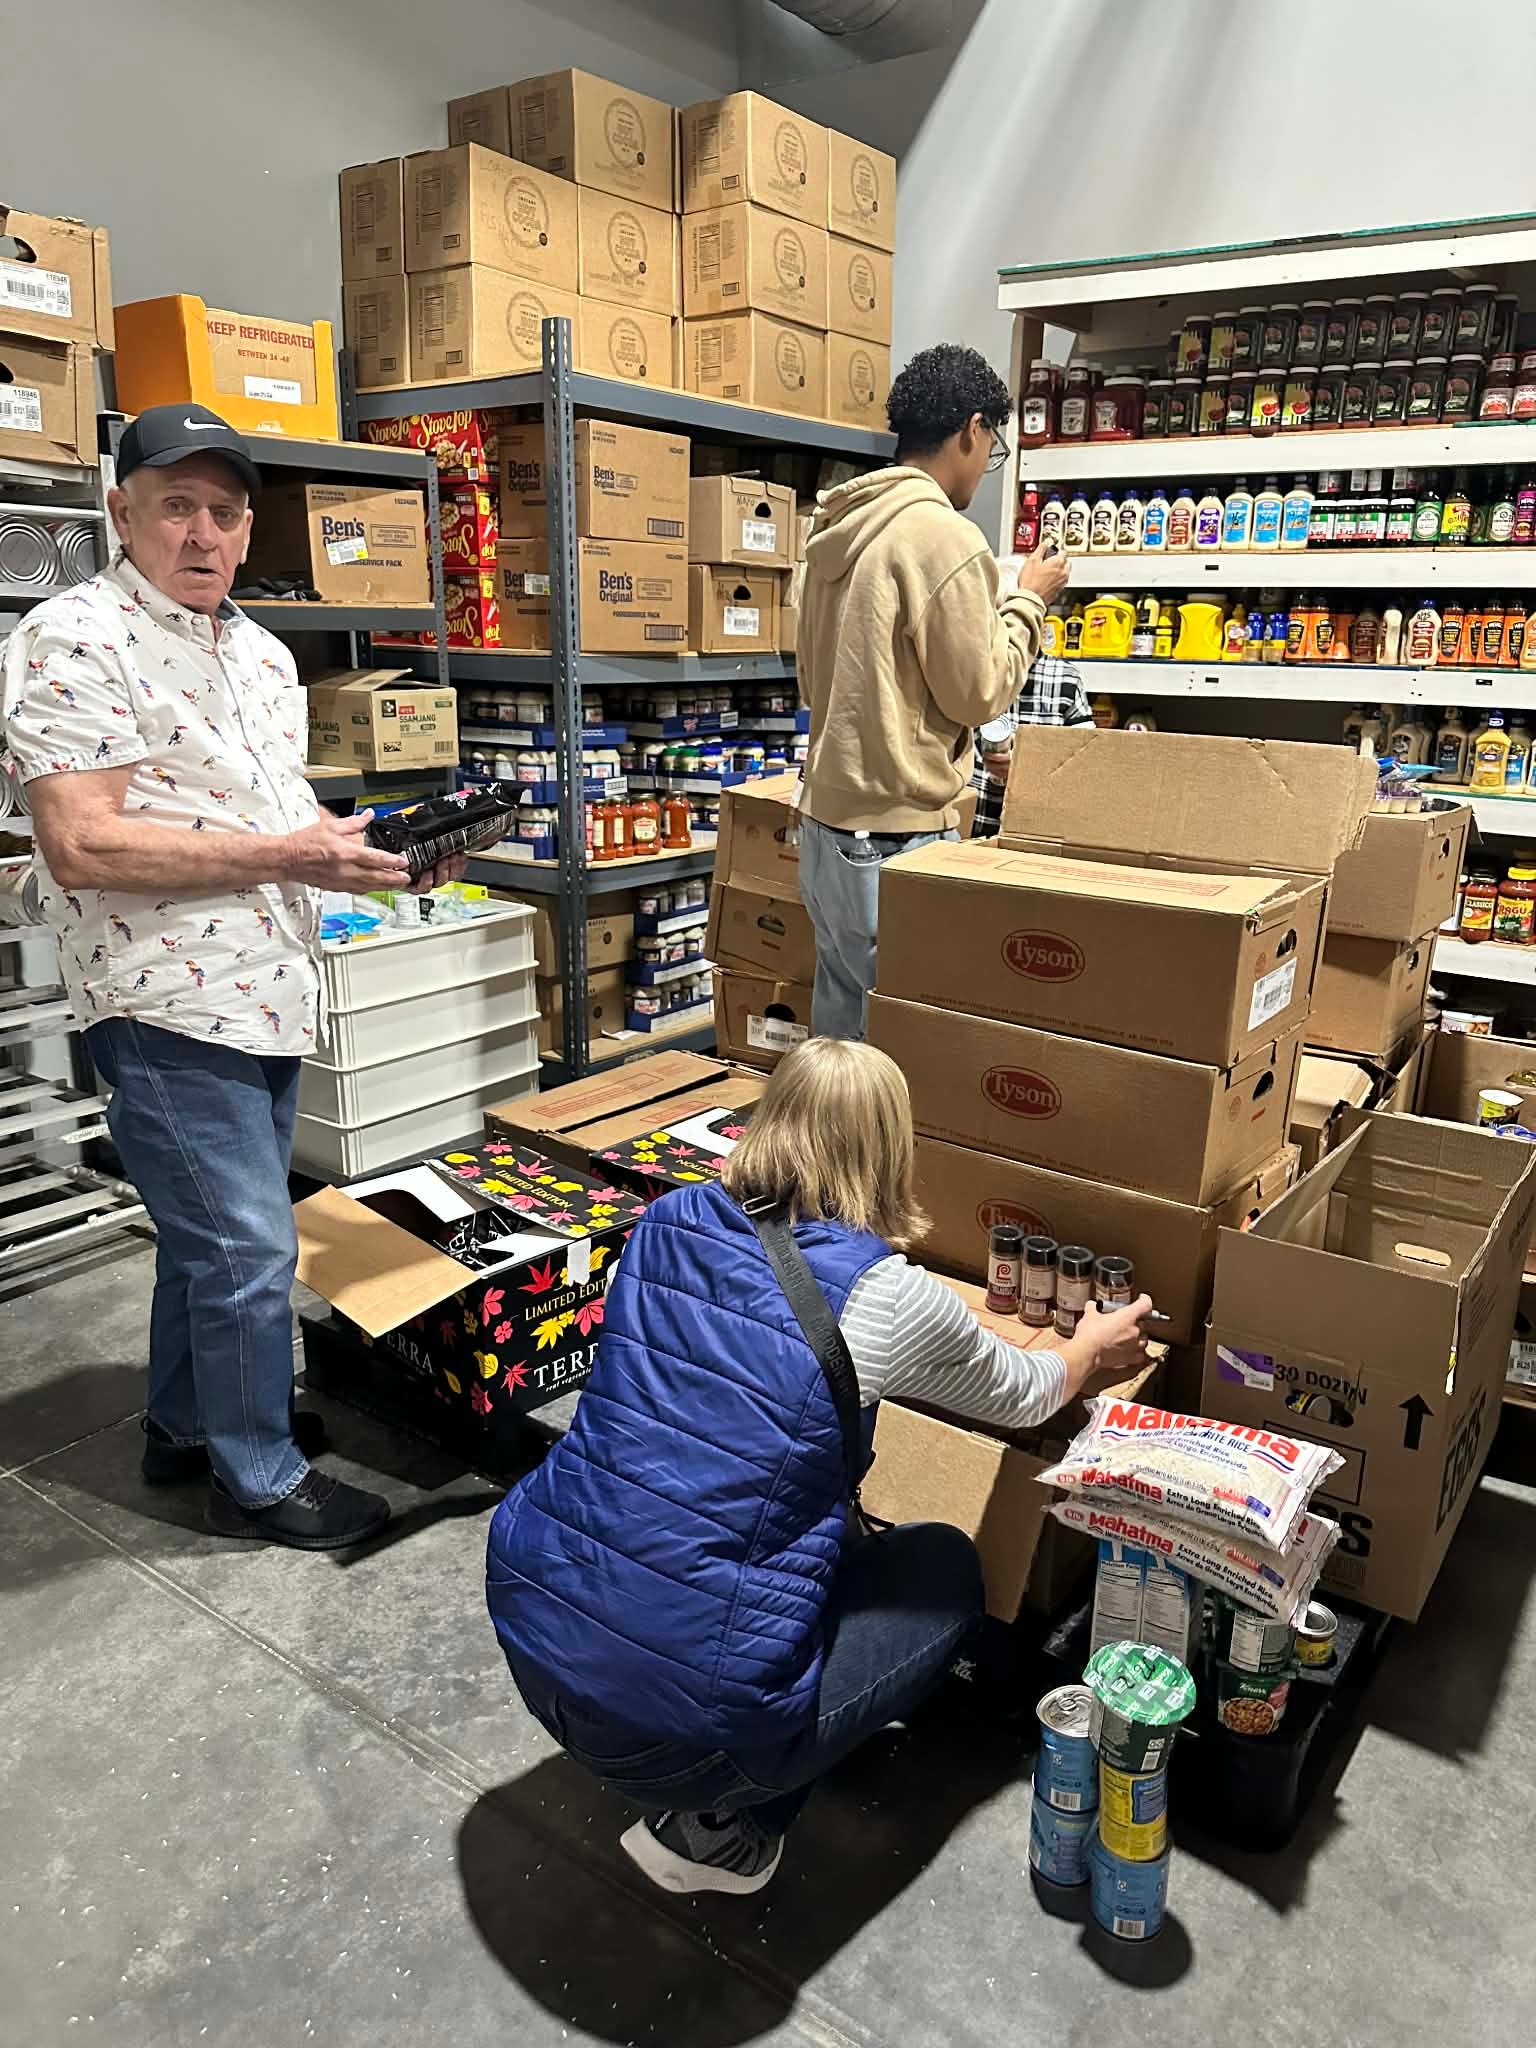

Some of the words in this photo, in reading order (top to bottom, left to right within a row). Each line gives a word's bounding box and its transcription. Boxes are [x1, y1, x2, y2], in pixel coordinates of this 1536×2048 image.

[206, 319, 237, 336] KEEP
[239, 325, 315, 349] REFRIGERATED
[593, 465, 615, 480] Ben's
[321, 515, 365, 538] Ben's
[599, 570, 632, 590] Ben's
[599, 590, 633, 605] Original
[1009, 936, 1076, 969] Tyson
[988, 1072, 1054, 1108] Tyson
[495, 1169, 534, 1190] LIMITED
[531, 1187, 574, 1209] EDITION
[525, 1290, 576, 1320] LIMITED
[579, 1279, 606, 1299] EDIT
[387, 1333, 433, 1374] ERRA
[1275, 1364, 1299, 1383] 30
[1226, 1439, 1252, 1454] RICE
[1081, 1467, 1163, 1502] Mahatma
[1166, 1488, 1189, 1501] Extra
[1190, 1496, 1211, 1509] Long
[1089, 1511, 1174, 1553] Mahatma
[1178, 1543, 1200, 1559] Extra
[1202, 1556, 1222, 1571] Long
[1223, 1565, 1257, 1589] Enriched
[1258, 1585, 1273, 1600] Rice
